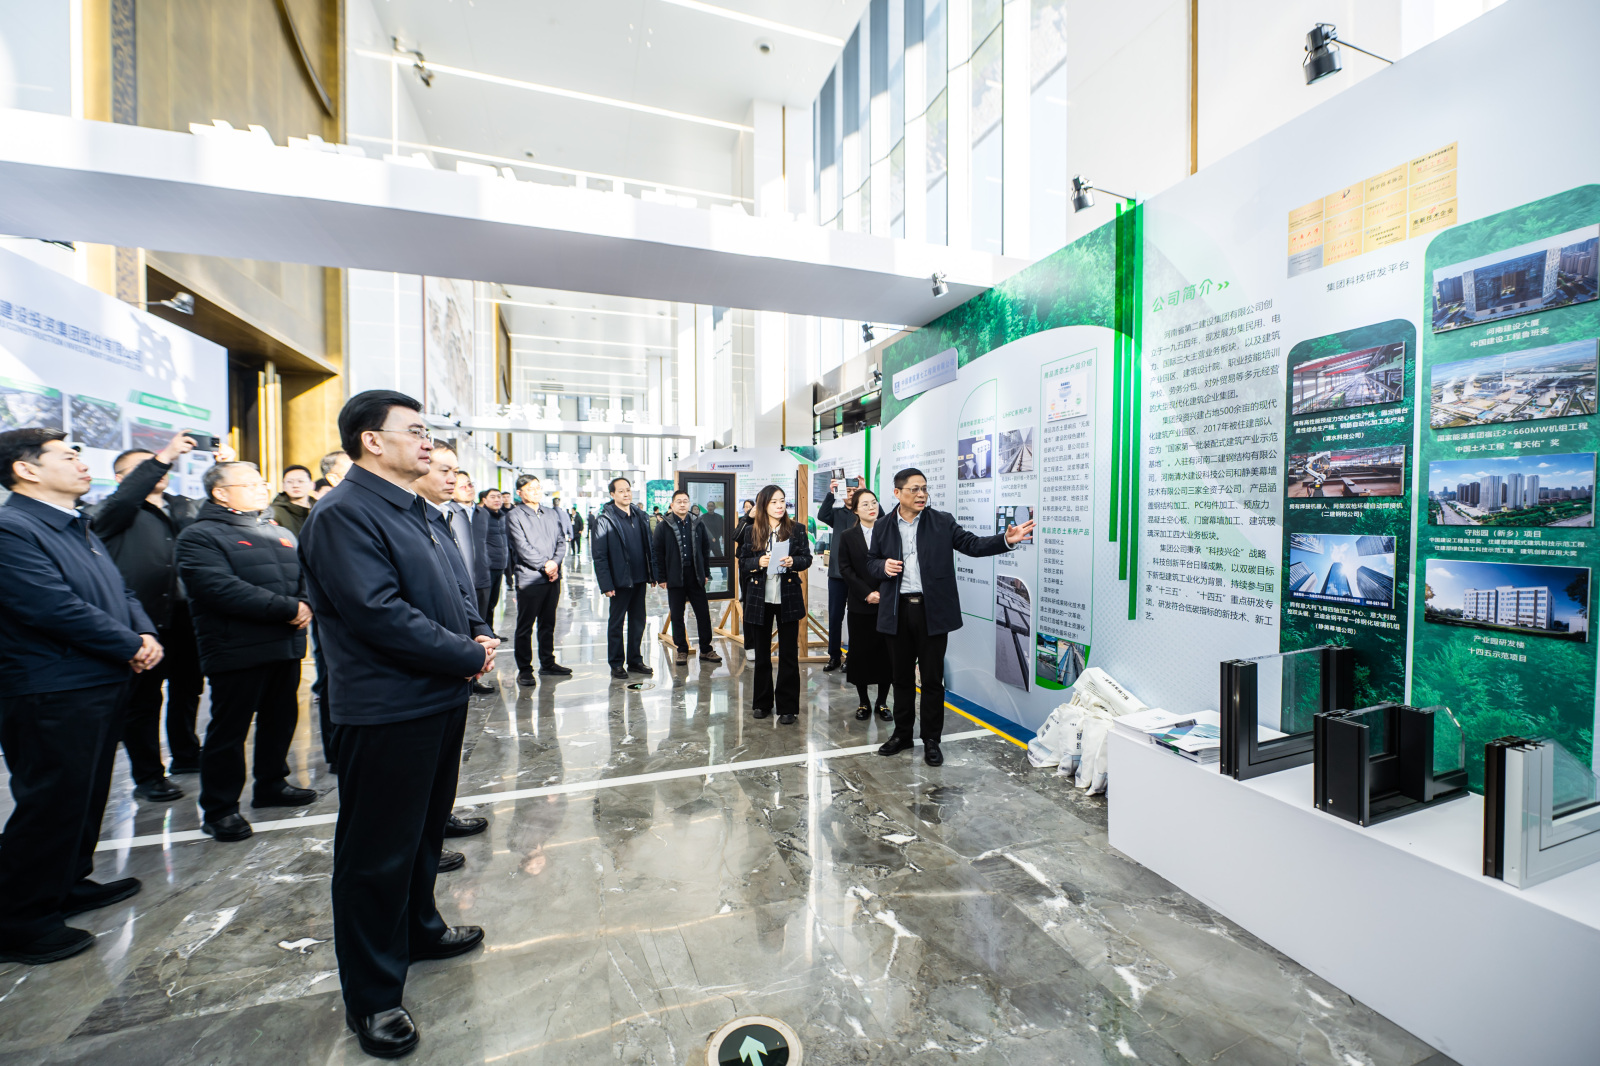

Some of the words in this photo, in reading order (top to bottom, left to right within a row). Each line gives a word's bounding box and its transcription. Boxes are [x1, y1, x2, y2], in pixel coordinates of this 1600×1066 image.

[1327, 260, 1410, 292] 集团科技研发平台
[1152, 278, 1213, 313] 公司简介
[1164, 298, 1273, 339] 河南省第二建设集团有限公司创
[1487, 318, 1540, 335] 河南建设大厦
[1470, 327, 1549, 347] 中国建设工程鲁班奖
[1150, 389, 1239, 412] 的大型现代化建筑企业集团。
[1163, 399, 1277, 425] 集团投资兴建占地500余亩的现代
[1149, 432, 1278, 454] 定为“国家第一批装配式建筑产业示范
[1147, 515, 1276, 526] 混凝土空心板、门窗幕墙加工、建筑玻
[1147, 529, 1219, 541] 璃深加工四大业务板块。
[1160, 543, 1266, 559] 集团公司秉承“科技兴企”战略
[1474, 635, 1525, 649] 产业园研发楼
[1467, 647, 1527, 662] 十四五示范项目
